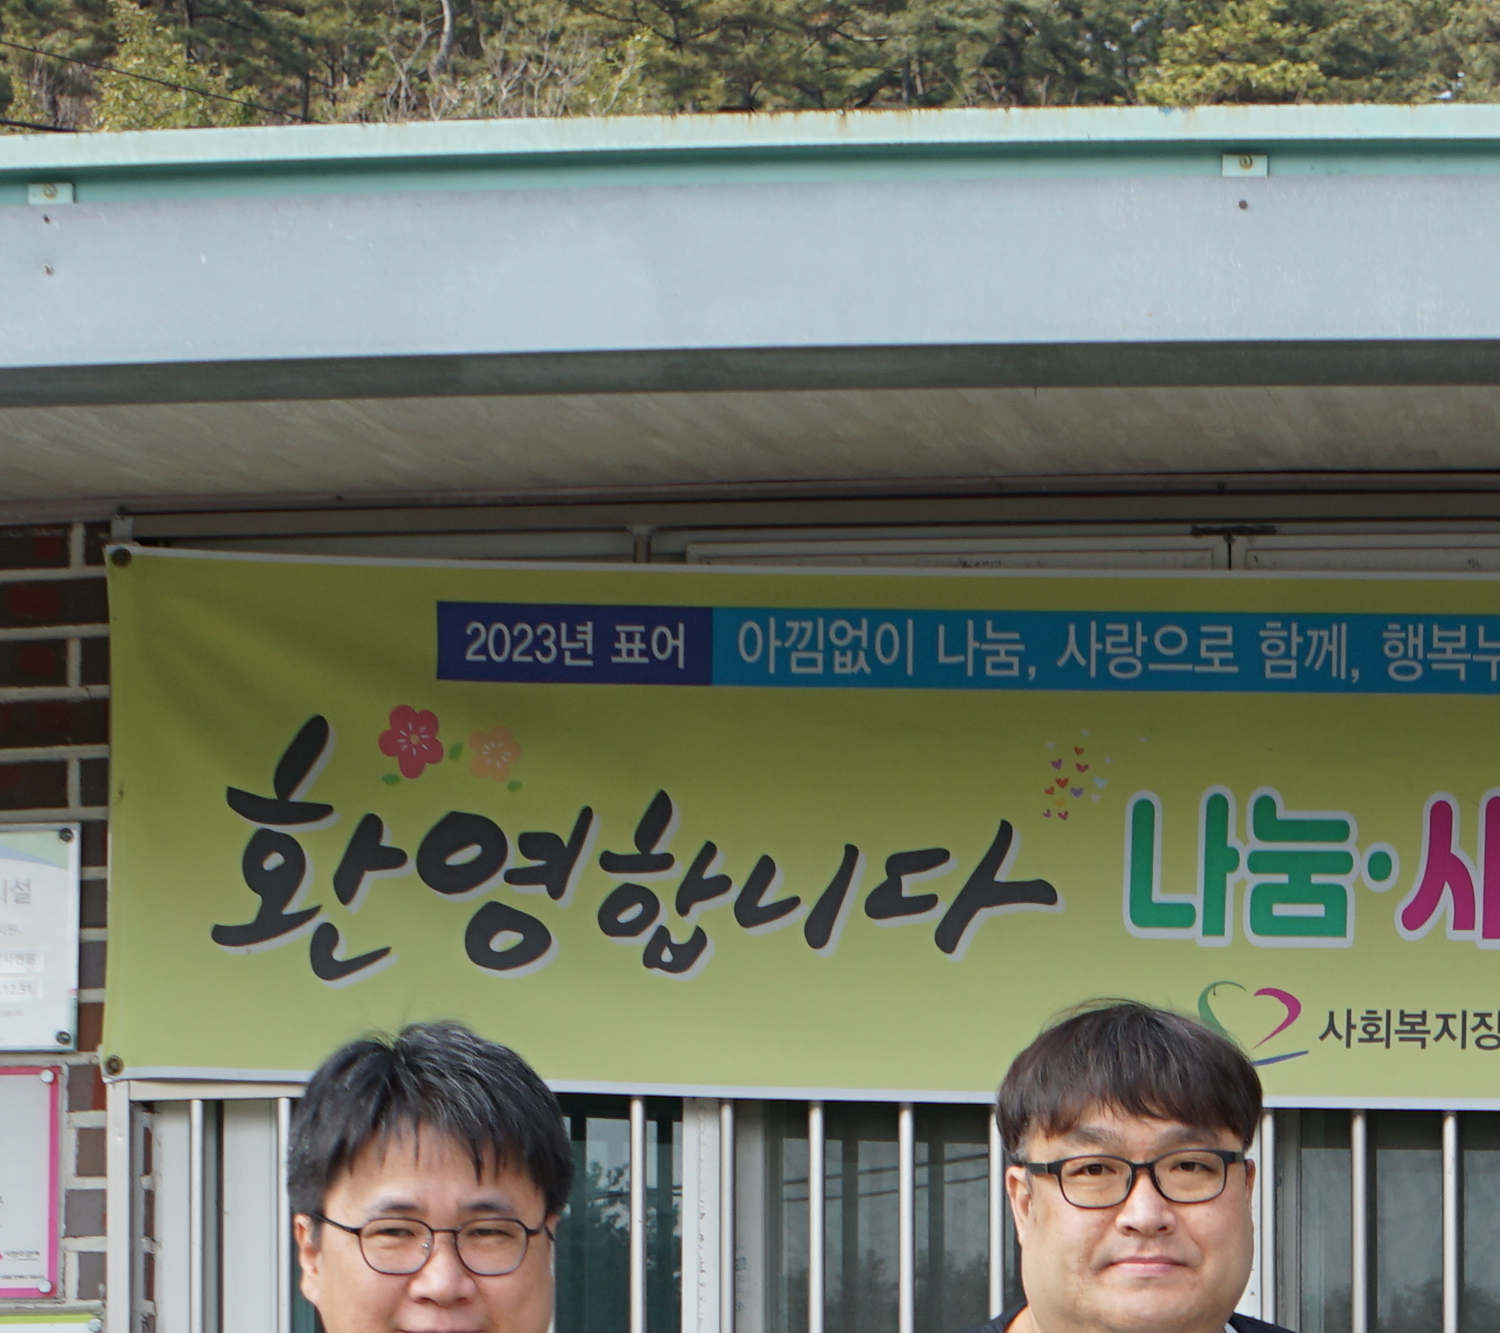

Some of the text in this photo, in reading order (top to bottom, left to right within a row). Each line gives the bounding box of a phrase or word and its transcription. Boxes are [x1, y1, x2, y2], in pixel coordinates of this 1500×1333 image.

[464, 619, 686, 669] 2023년 표어
[737, 617, 914, 675] 아낌없이
[937, 619, 1037, 681] 나눔,
[1056, 620, 1240, 679] 사랑으로
[1259, 621, 1361, 684] 함께,
[210, 713, 1058, 980] 환영합니다
